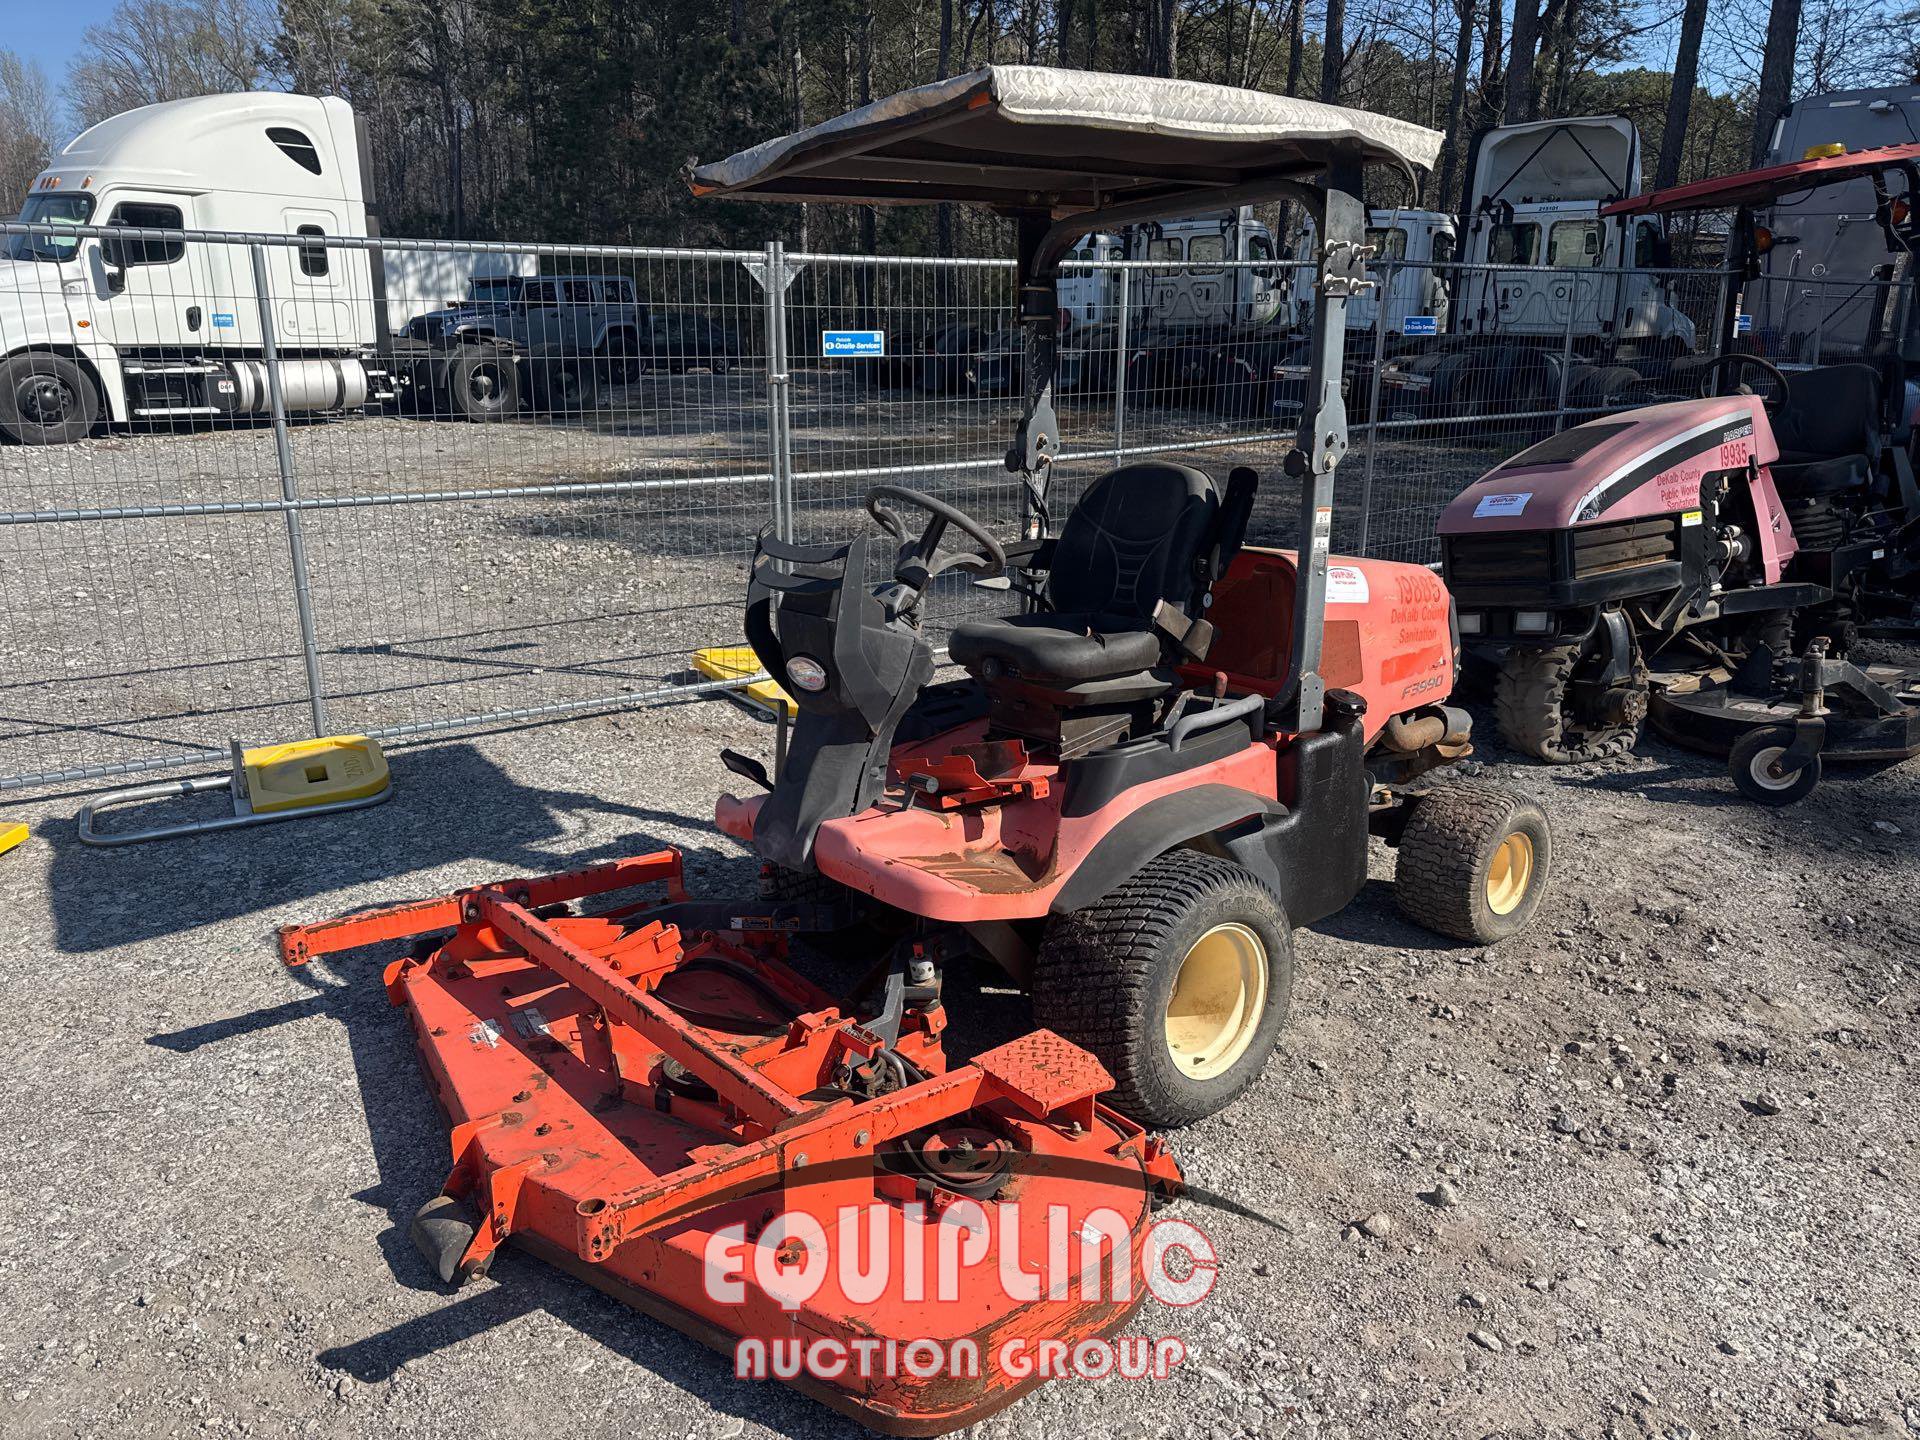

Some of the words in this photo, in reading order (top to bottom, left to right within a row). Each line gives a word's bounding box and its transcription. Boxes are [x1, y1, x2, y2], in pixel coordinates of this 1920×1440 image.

[1722, 423, 1753, 443] HARPER
[1719, 442, 1748, 468] 19935
[1656, 471, 1679, 487] DeKalb
[1680, 469, 1701, 482] County
[1660, 489, 1679, 502] Public
[1680, 485, 1699, 497] Works
[1666, 498, 1697, 509] Sanitation
[1390, 607, 1419, 624] DeKalb
[1421, 606, 1447, 622] County
[1399, 627, 1437, 643] Sanitation
[1400, 674, 1443, 700] F3990
